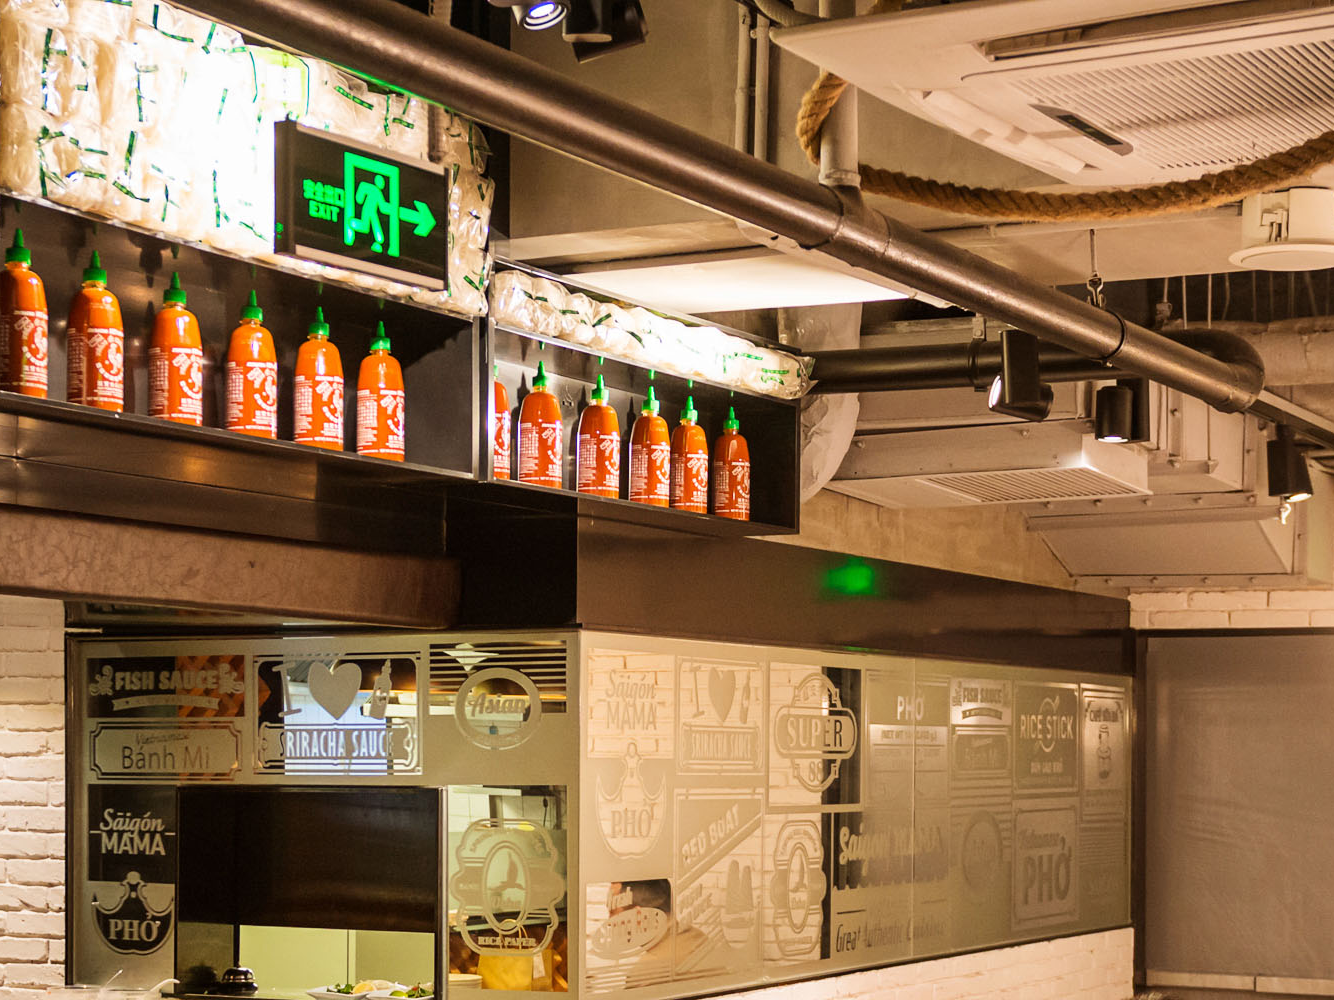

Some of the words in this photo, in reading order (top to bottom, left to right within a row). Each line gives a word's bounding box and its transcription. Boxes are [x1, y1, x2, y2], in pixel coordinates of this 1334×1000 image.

[308, 200, 340, 222] EXIT
[115, 671, 154, 690] FISH
[159, 670, 218, 690] SAUCE
[468, 692, 526, 718] Asian
[607, 701, 657, 731] MAMA
[787, 718, 842, 747] SUPER
[1020, 714, 1043, 739] RICE
[1046, 715, 1073, 739] STICK
[279, 731, 346, 757] SRIRACHA
[352, 730, 393, 758] SAUCE
[122, 745, 176, 770] Bánh
[101, 831, 166, 856] MAMA
[682, 831, 707, 865] RED
[708, 803, 740, 847] BOAT
[478, 937, 502, 946] RICE
[504, 937, 537, 947] PAPER
[835, 923, 862, 952] Great
